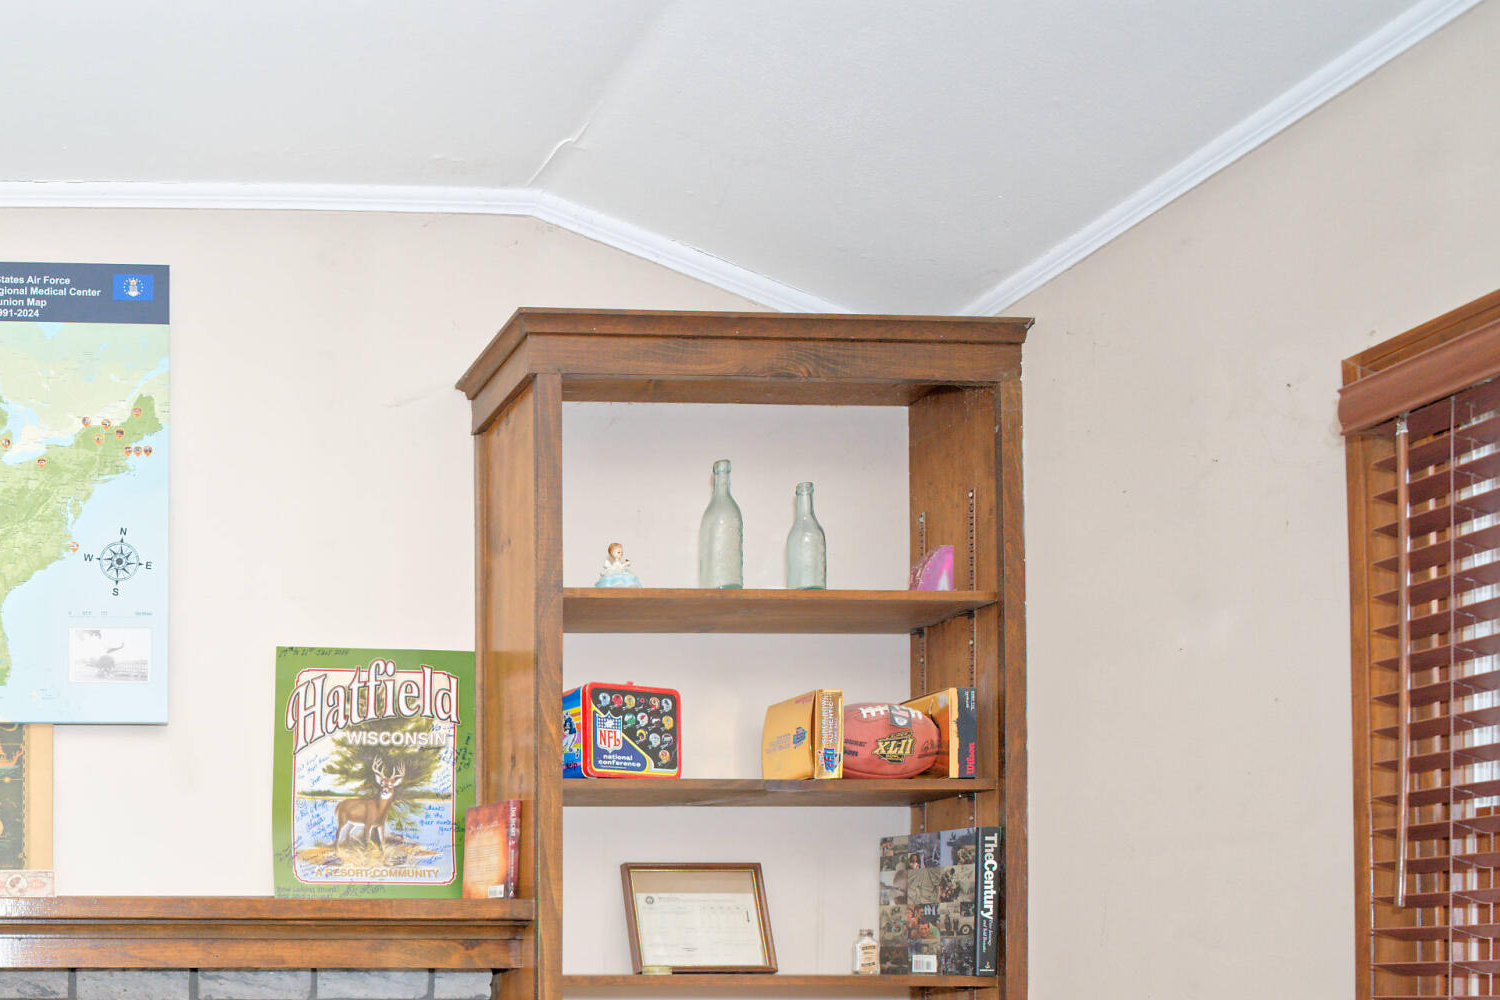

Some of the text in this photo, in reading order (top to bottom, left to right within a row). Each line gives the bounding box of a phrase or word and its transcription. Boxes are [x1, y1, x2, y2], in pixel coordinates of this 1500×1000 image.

[26, 275, 41, 284] Air
[43, 276, 70, 285] Force
[30, 287, 66, 296] Medical
[69, 288, 101, 297] Center
[26, 298, 47, 308] Map
[120, 527, 127, 536] N
[83, 553, 94, 562] W
[145, 561, 152, 570] E
[112, 588, 119, 596] S
[285, 658, 461, 755] Hatfield
[346, 731, 446, 746] WISCONSIN
[599, 729, 621, 748] NFL
[871, 738, 917, 755] XLII
[598, 759, 642, 768] conference
[823, 747, 835, 774] XLII
[966, 742, 976, 775] Wilson
[315, 868, 439, 878] A RESORT COMMUNITY
